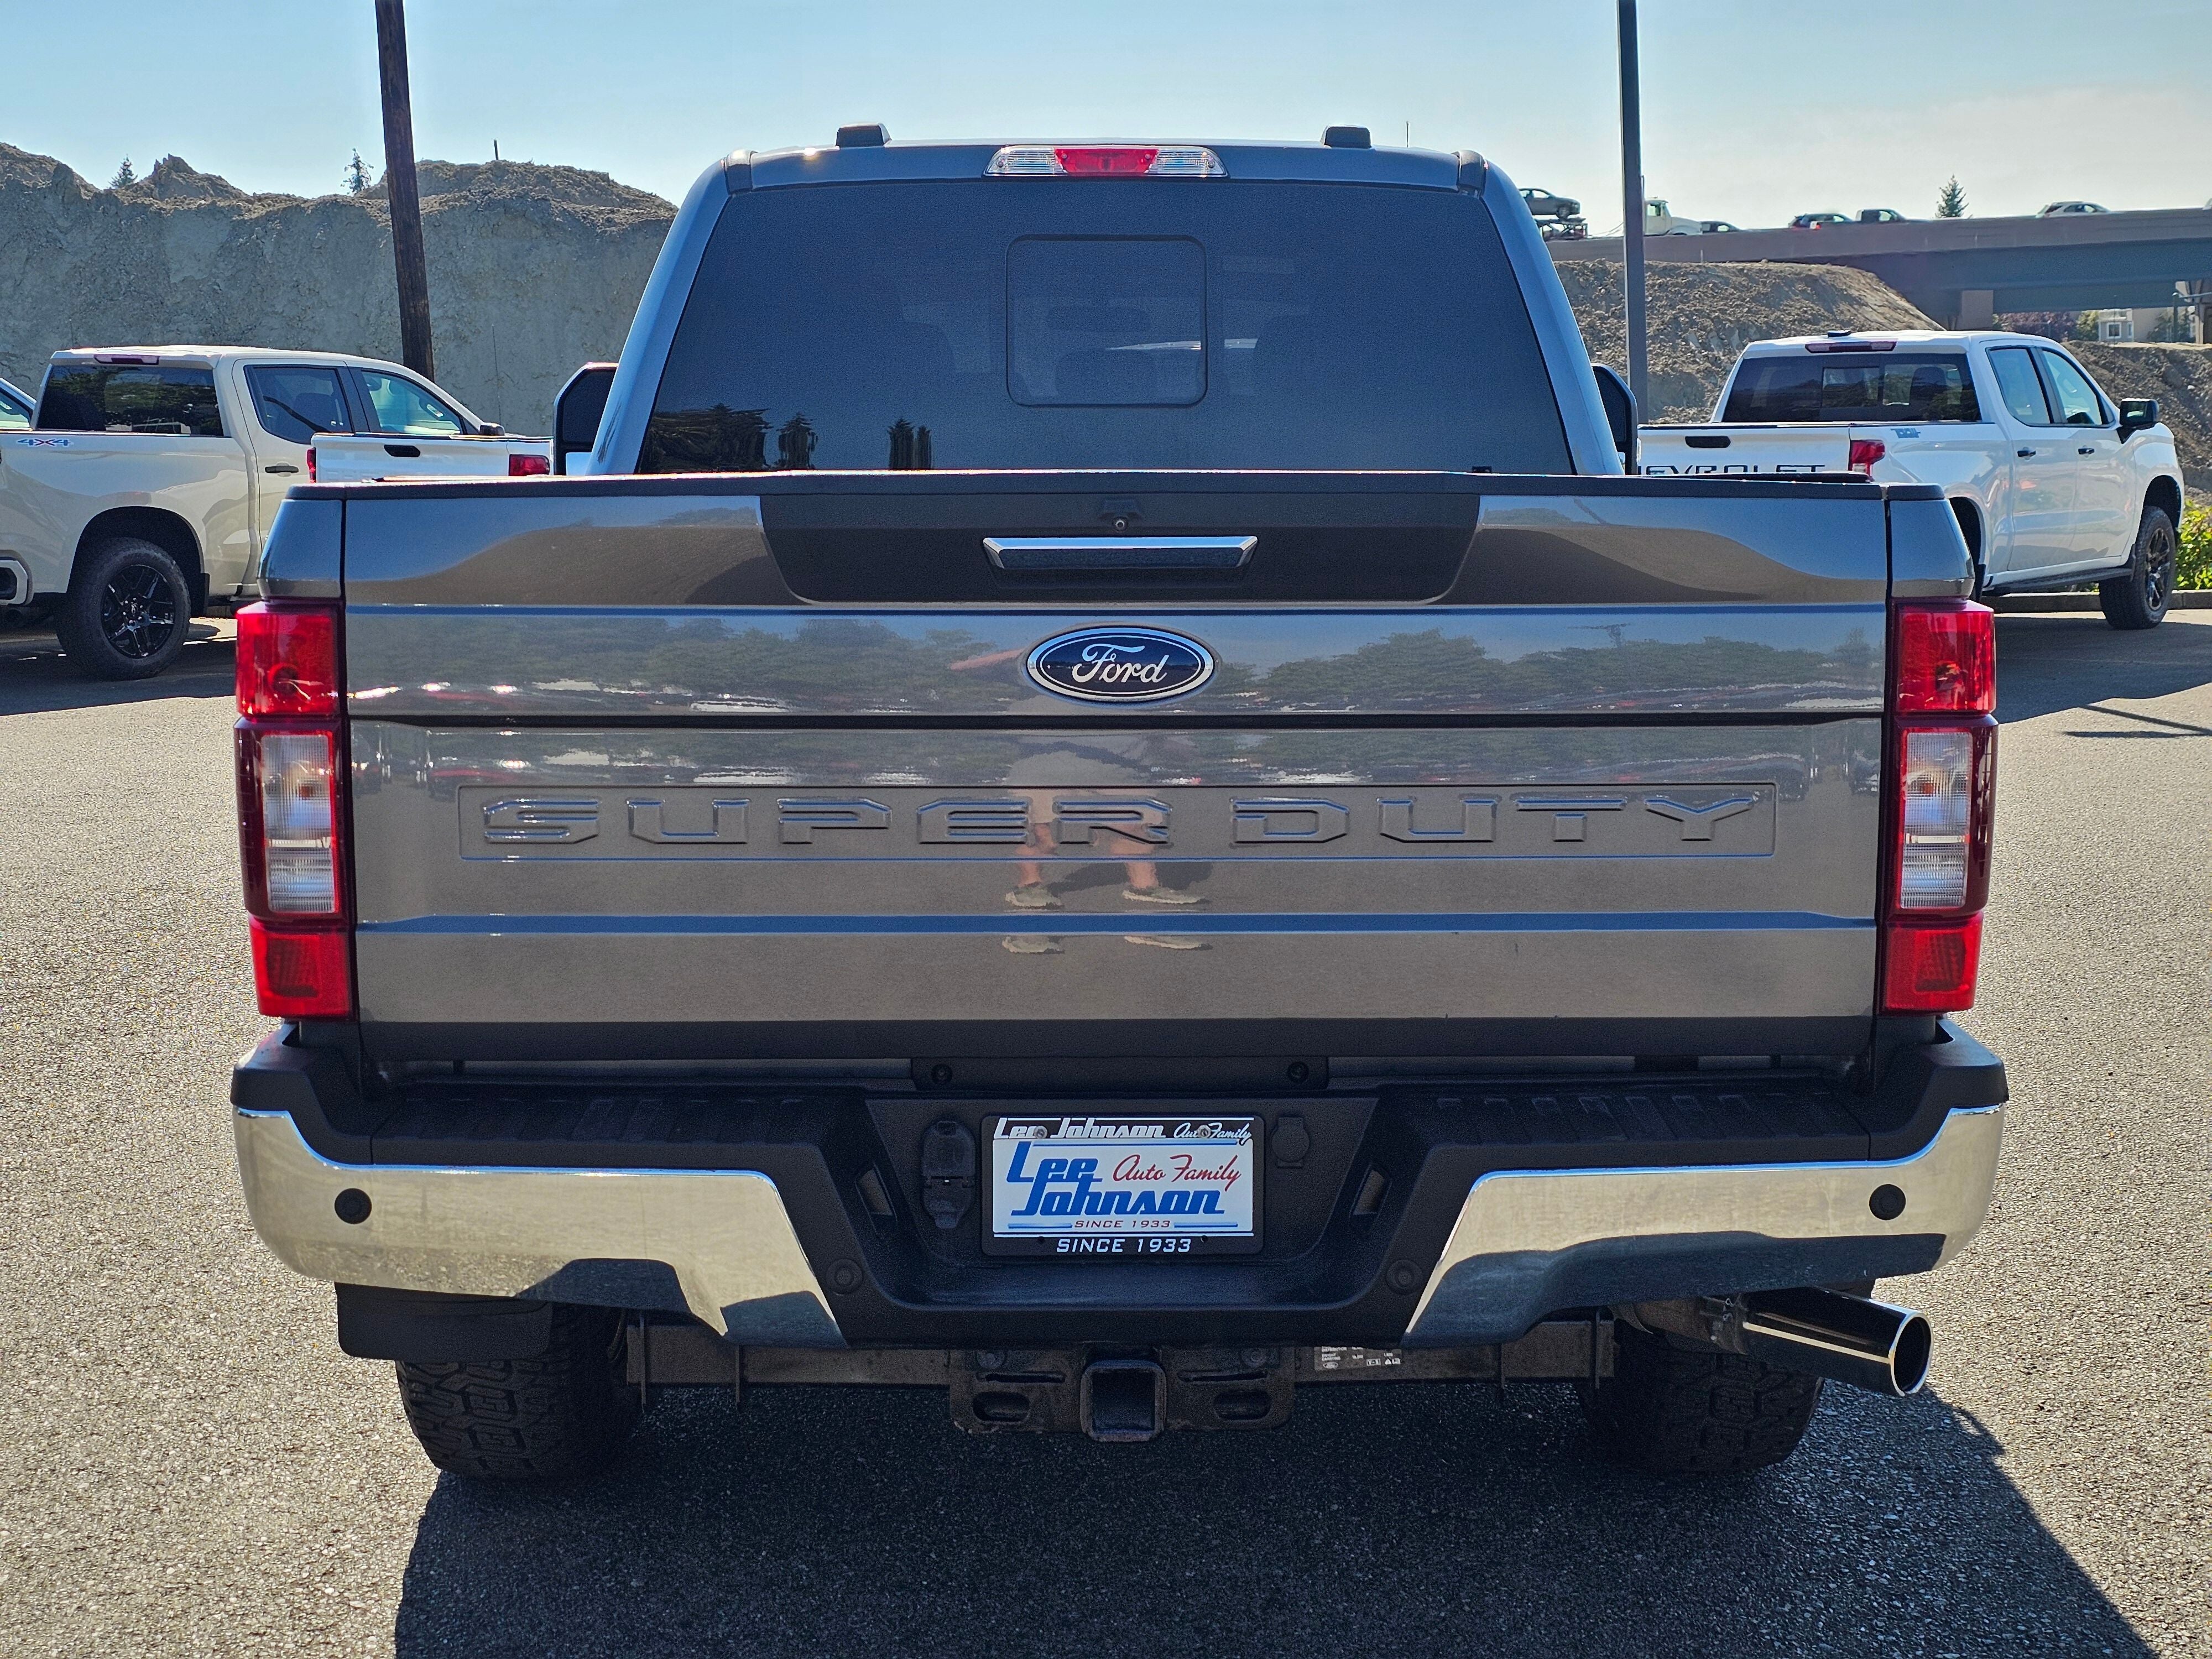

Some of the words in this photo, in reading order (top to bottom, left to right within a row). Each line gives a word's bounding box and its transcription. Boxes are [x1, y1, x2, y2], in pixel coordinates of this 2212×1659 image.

[1072, 643, 1170, 682] Ford
[483, 798, 1171, 846] SUPER
[1230, 795, 1754, 845] DUTY
[1050, 1117, 1166, 1138] Johnson
[1173, 1122, 1204, 1139] Aut
[1208, 1122, 1252, 1145] Family
[1006, 1141, 1103, 1183] Lee
[1113, 1154, 1166, 1182] Auto
[1170, 1154, 1241, 1192] Family
[1011, 1172, 1225, 1216] Johnson
[1074, 1220, 1124, 1228] SINCE
[1133, 1220, 1171, 1228] 1933
[1056, 1238, 1125, 1253] SINCE
[1138, 1238, 1191, 1253] 1933
